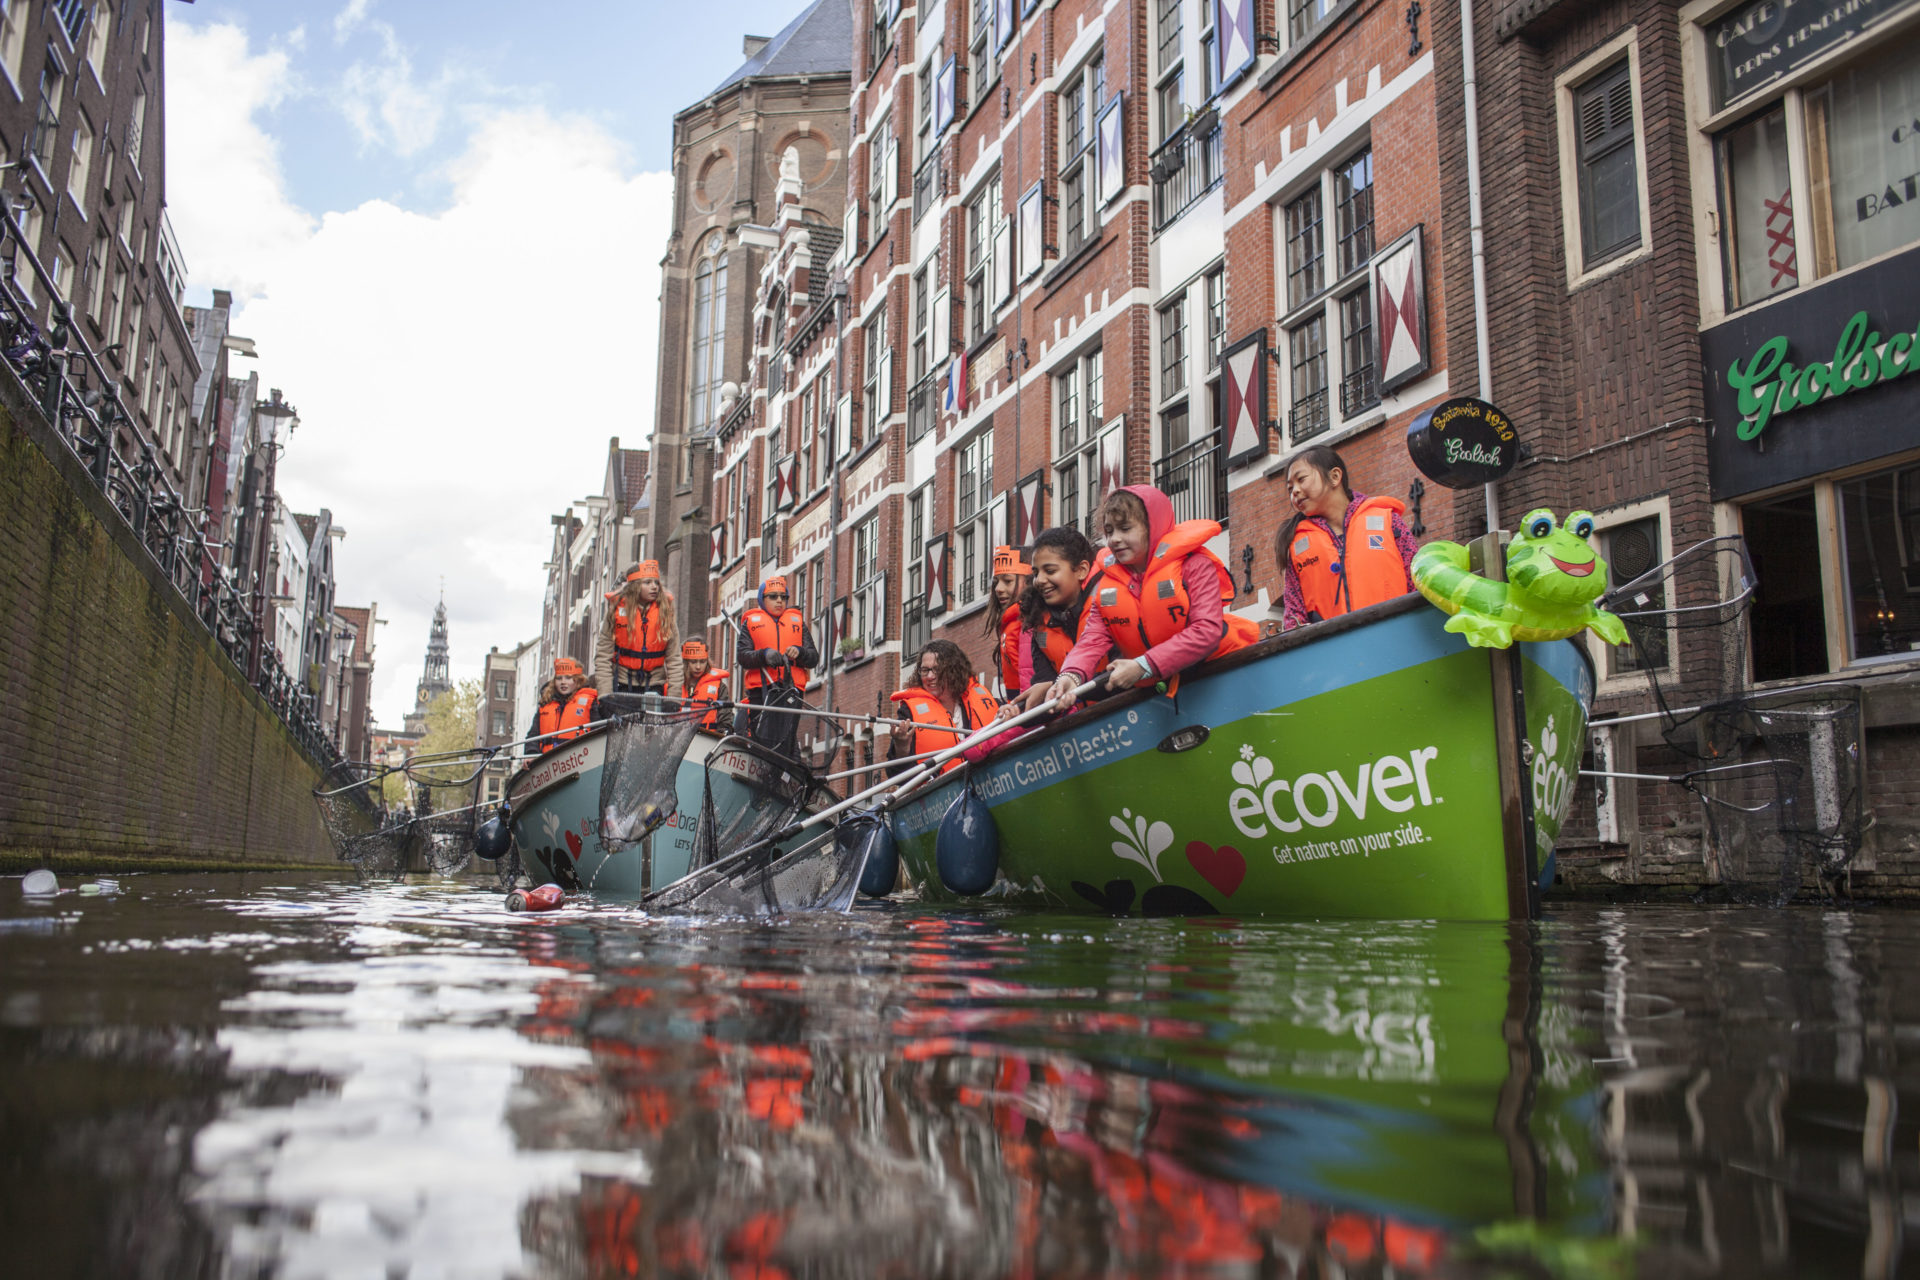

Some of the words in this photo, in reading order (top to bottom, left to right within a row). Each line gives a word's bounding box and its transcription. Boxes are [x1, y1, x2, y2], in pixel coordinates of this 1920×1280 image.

[1735, 43, 1781, 79] PRINS
[1485, 409, 1514, 442] 1920
[1444, 438, 1502, 467] Grolsch
[722, 748, 747, 771] This
[954, 769, 1015, 801] erdam
[1014, 751, 1061, 786] Canal
[531, 766, 552, 789] Canal
[1272, 844, 1296, 864] Get
[1295, 839, 1340, 862] nature
[1340, 837, 1359, 855] on
[1358, 830, 1392, 858] your
